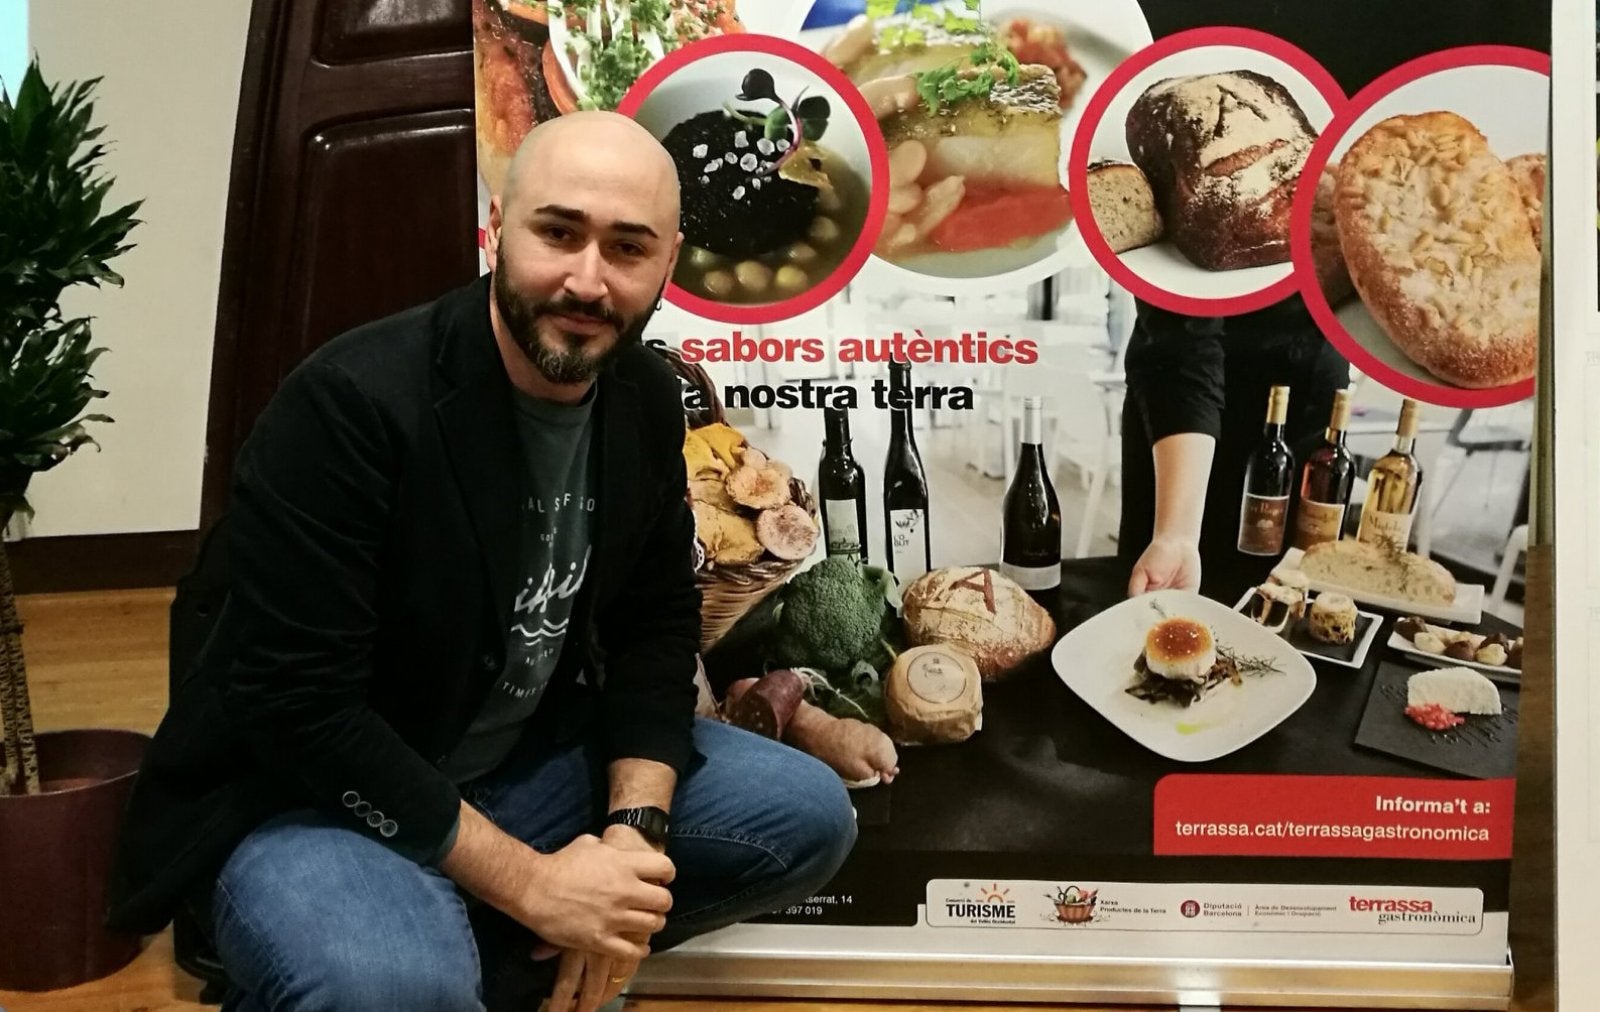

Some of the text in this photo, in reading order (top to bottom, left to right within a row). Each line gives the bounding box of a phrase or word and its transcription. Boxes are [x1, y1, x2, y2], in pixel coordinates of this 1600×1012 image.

[681, 331, 825, 363] sabors
[838, 330, 1039, 364] autèntics
[724, 380, 858, 409] nostra
[872, 379, 974, 410] terra
[1473, 801, 1491, 814] a:
[1175, 820, 1490, 842] terrassa.cat/terrassagastronomica
[805, 895, 853, 905] serrat, 14
[1203, 902, 1242, 911] Diputació
[1349, 895, 1433, 913] terrassa
[805, 906, 823, 915] 019
[945, 903, 1016, 918] TURISME
[1378, 910, 1476, 925] gastronòmica
